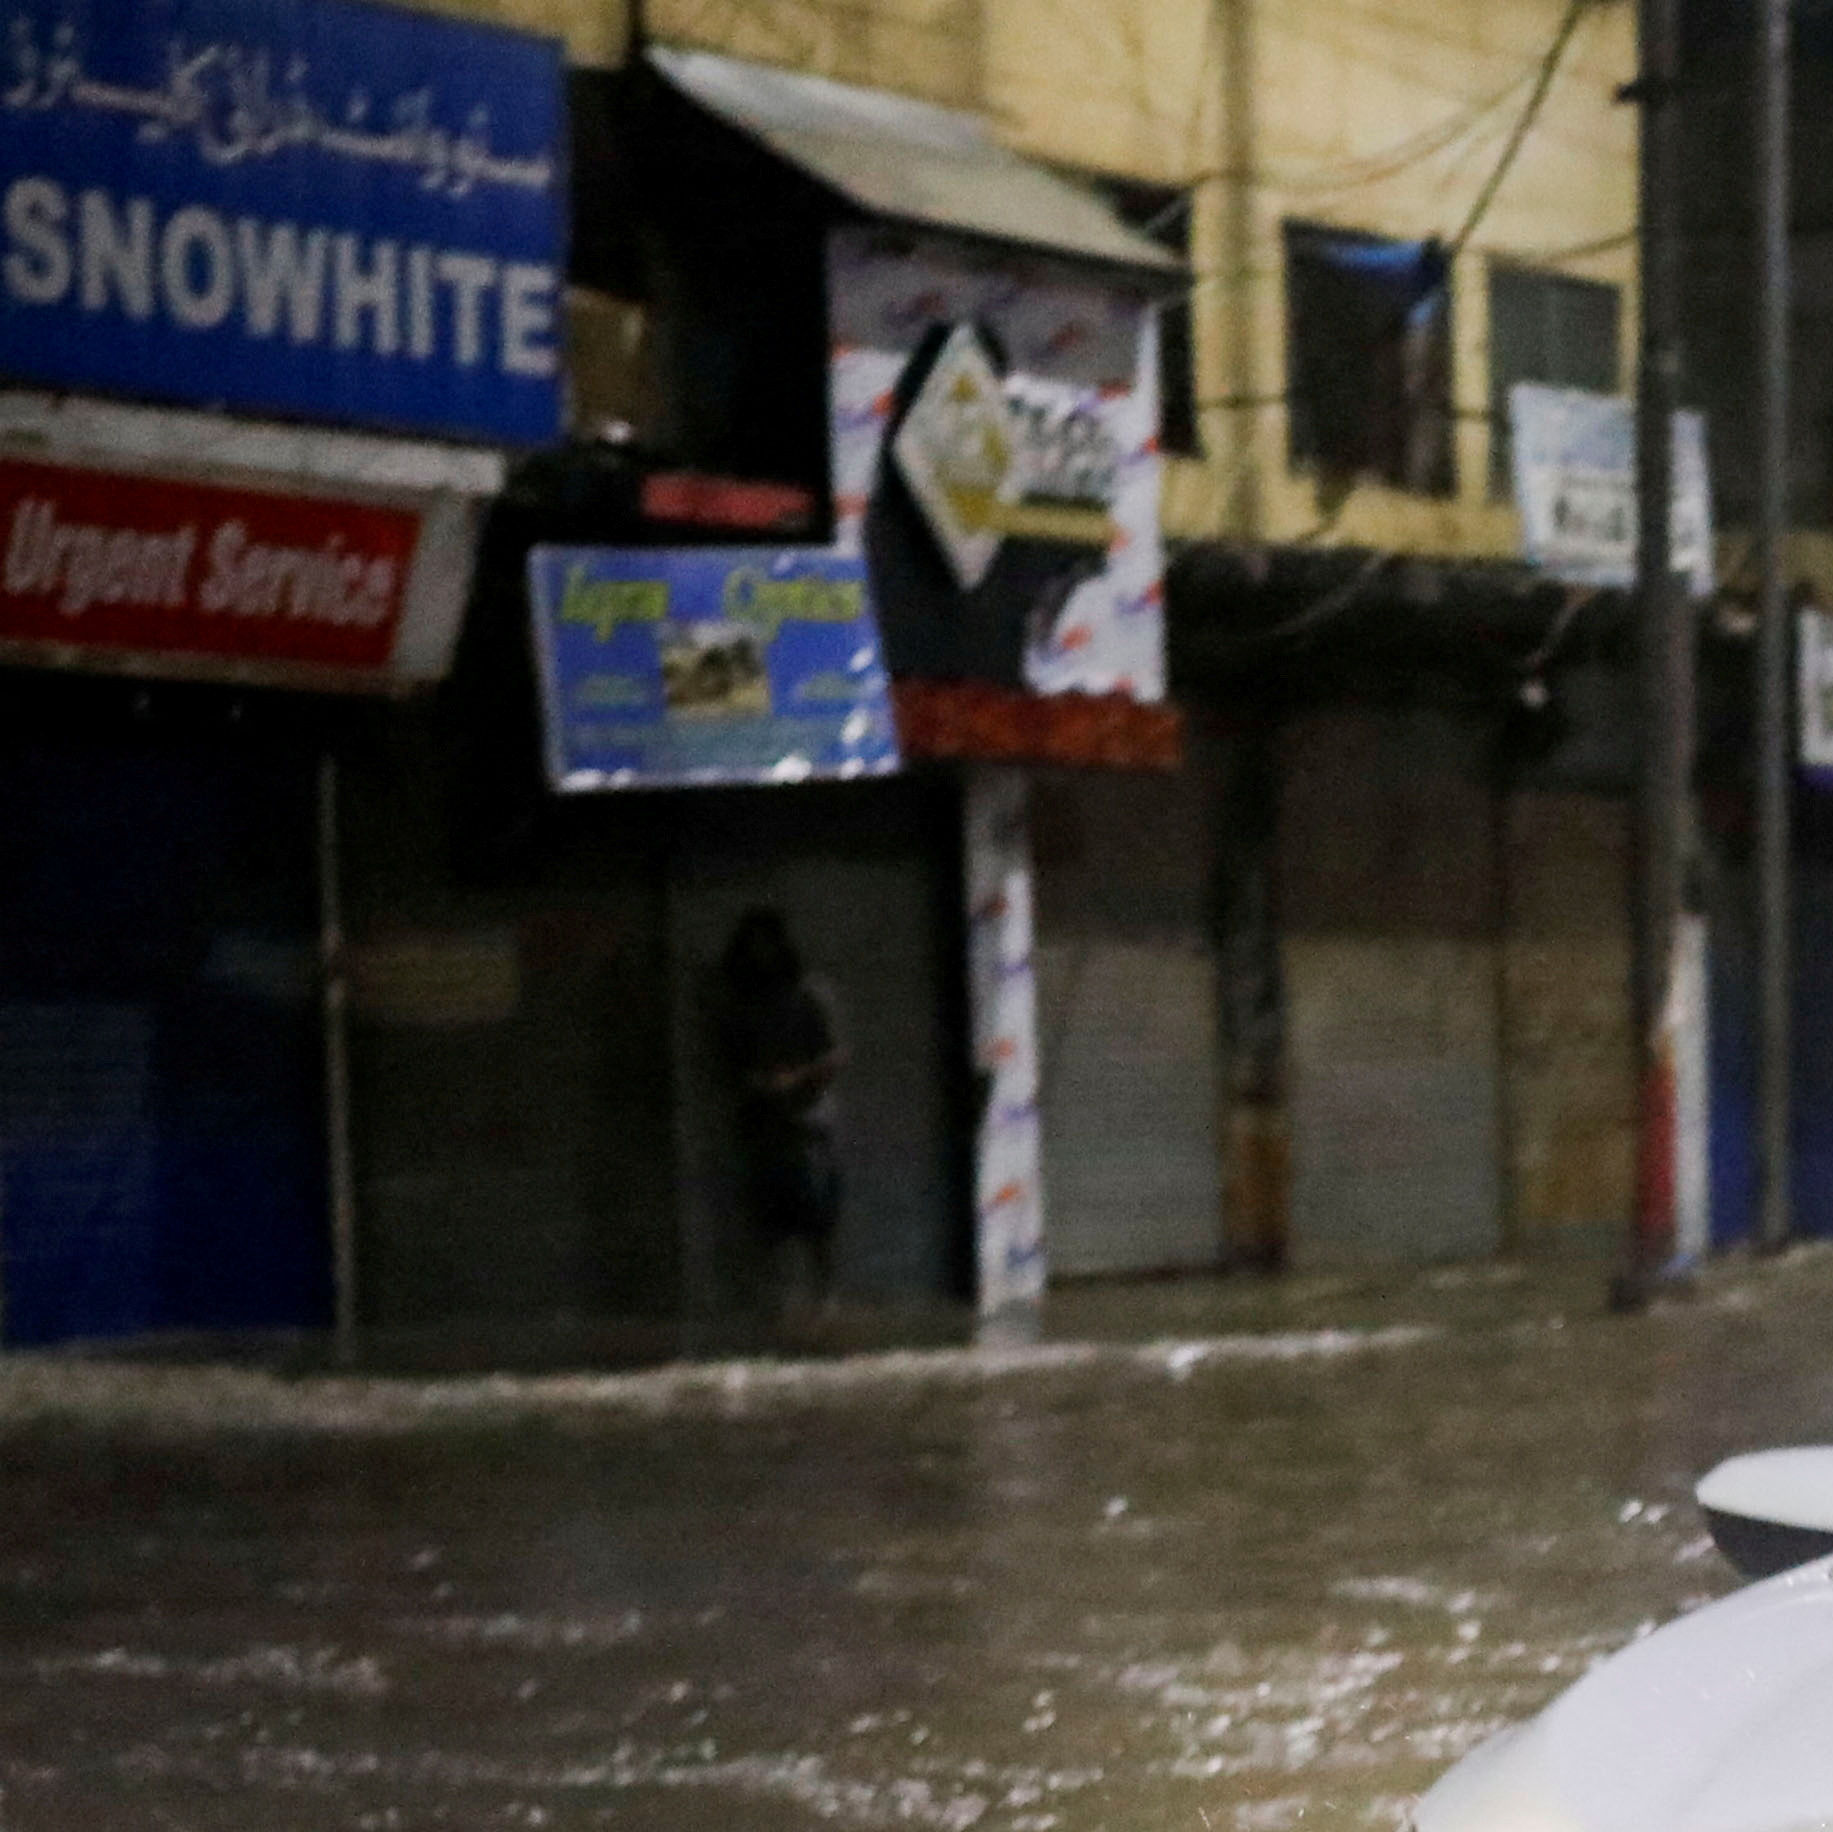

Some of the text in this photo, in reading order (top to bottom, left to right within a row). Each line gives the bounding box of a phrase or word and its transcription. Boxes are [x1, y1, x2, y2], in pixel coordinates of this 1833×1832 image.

[3, 175, 557, 378] SNOWHITE
[3, 496, 398, 626] Urgent Service
